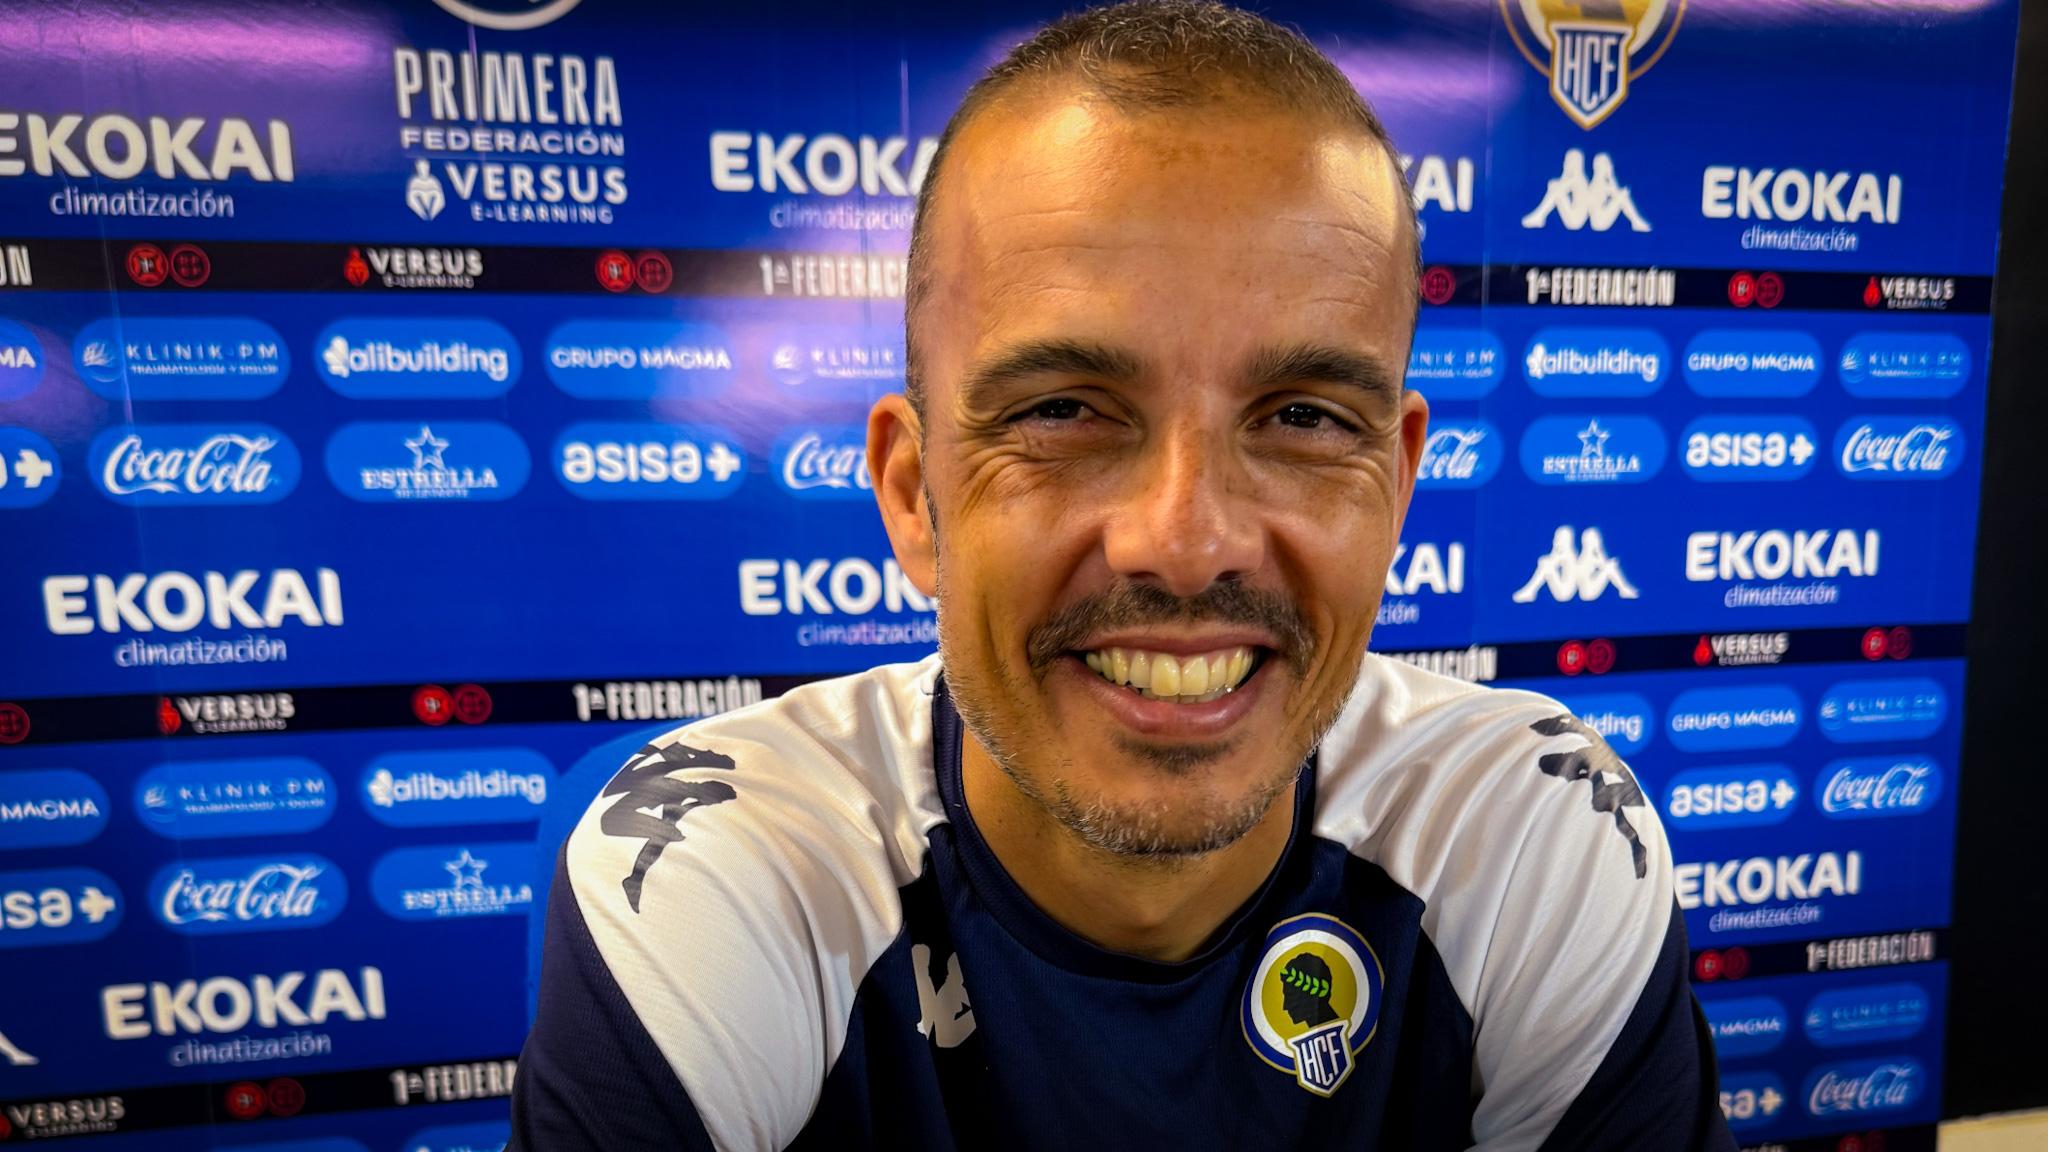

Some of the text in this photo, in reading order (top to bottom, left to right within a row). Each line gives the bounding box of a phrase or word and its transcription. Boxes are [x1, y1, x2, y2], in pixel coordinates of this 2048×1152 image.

[395, 48, 622, 126] PRIMERA
[1563, 33, 1618, 111] HCF
[401, 127, 625, 156] FEDERACIÓN
[445, 161, 628, 204] VERSUS
[1701, 165, 1902, 224] EKOKAI
[50, 187, 235, 219] climatización
[470, 202, 614, 225] E-LEARNING
[1741, 225, 1859, 251] climatización
[366, 248, 483, 276] VERSUS
[1551, 265, 1676, 306] FEDERACIÓN
[1880, 276, 1955, 300] VERSUS
[350, 342, 509, 381] alibuilding
[551, 346, 732, 370] GRUPO MAGMA
[1541, 349, 1659, 382] alibuilding
[1688, 352, 1815, 372] GRUPO MAGMA
[360, 467, 499, 491] ESTRELLA
[1542, 455, 1641, 475] ESTRELLA
[1685, 529, 1880, 582] EKOKAI
[43, 567, 344, 635] EKOKAI
[738, 557, 938, 616] EKOK
[114, 635, 288, 667] climatización
[1710, 632, 1789, 656] VERSUS
[176, 693, 296, 722] VERSUS
[605, 675, 762, 721] FEDERACIÓN
[1671, 707, 1796, 732] GRUPO MAGMA
[392, 769, 547, 804] alibuilding
[0, 798, 101, 821] MAGMA
[1673, 850, 1861, 910] EKOKAI
[403, 885, 533, 911] ESTRELLA
[1826, 930, 1936, 970] FEDERACIÓN
[102, 966, 388, 1041] EKOKAI
[168, 1029, 333, 1067] climatización
[1301, 1031, 1341, 1086] HCF
[7, 1096, 126, 1128] VERSUS
